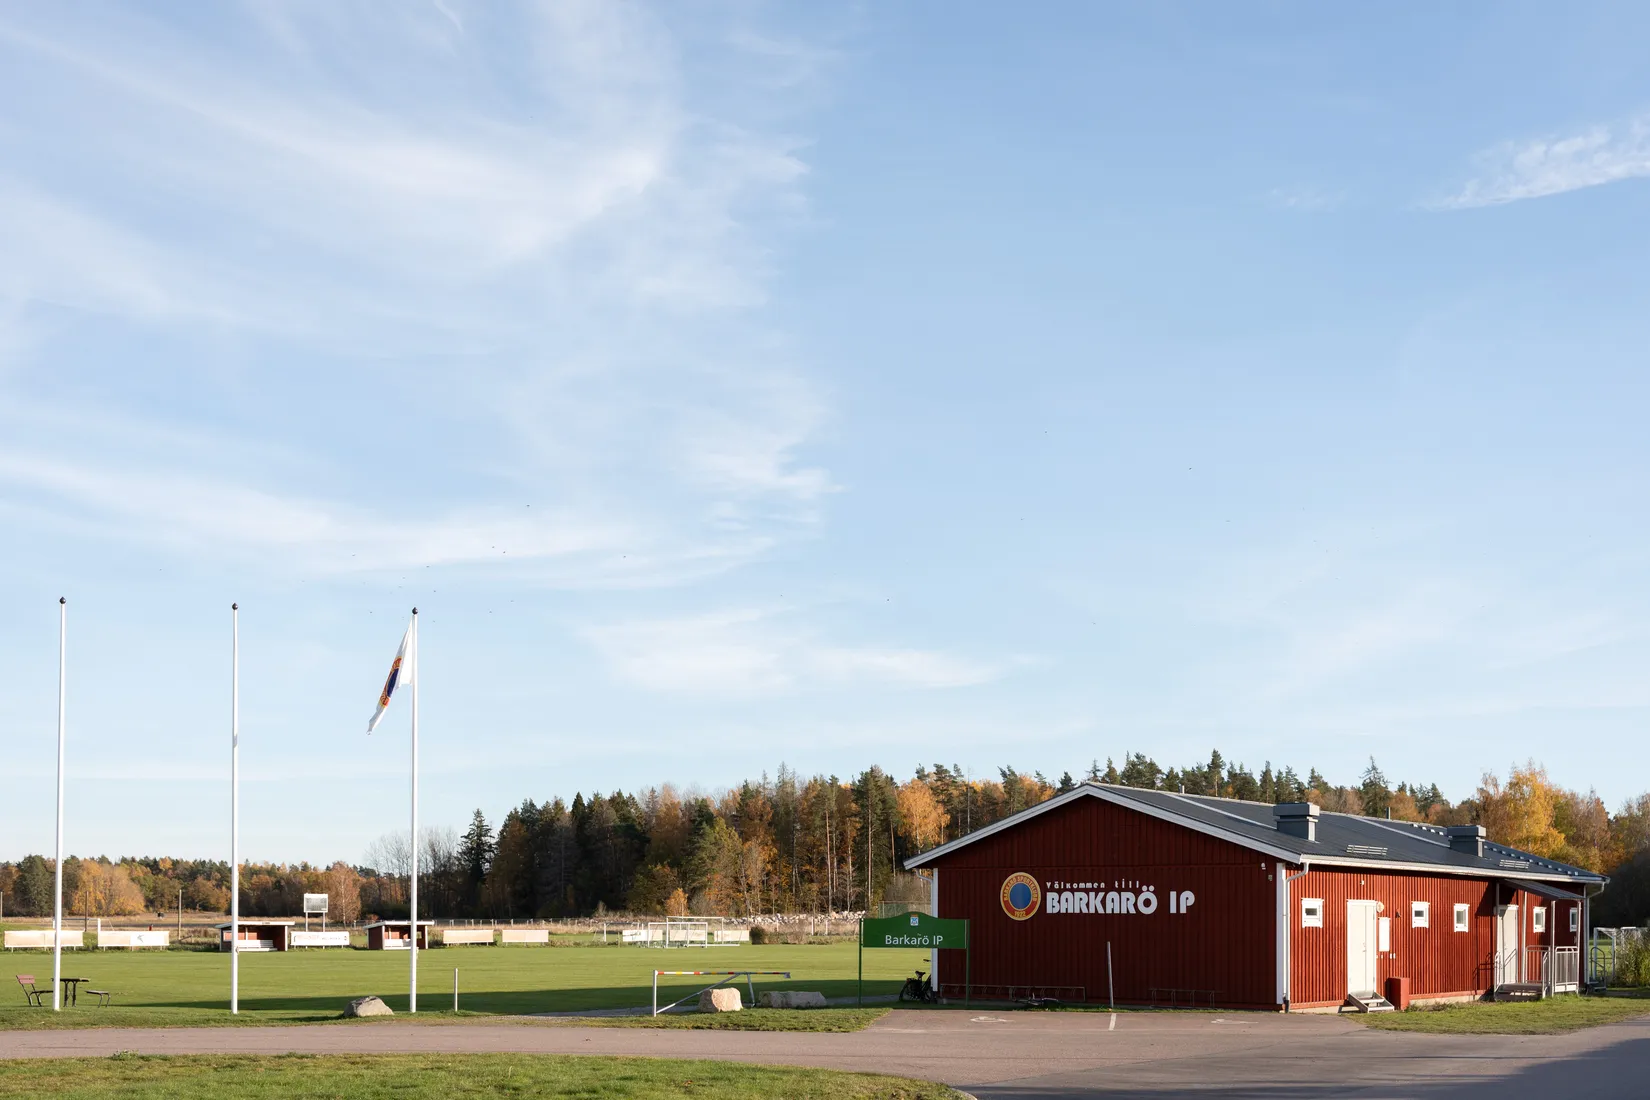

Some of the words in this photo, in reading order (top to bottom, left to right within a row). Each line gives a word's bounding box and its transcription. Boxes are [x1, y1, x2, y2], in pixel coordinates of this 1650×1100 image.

[1046, 881, 1105, 889] Välkommen
[1114, 878, 1139, 889] till
[1046, 885, 1158, 915] BARKARÖ
[1169, 890, 1195, 914] IP
[885, 934, 929, 945] Barkarö
[933, 935, 943, 945] IP
